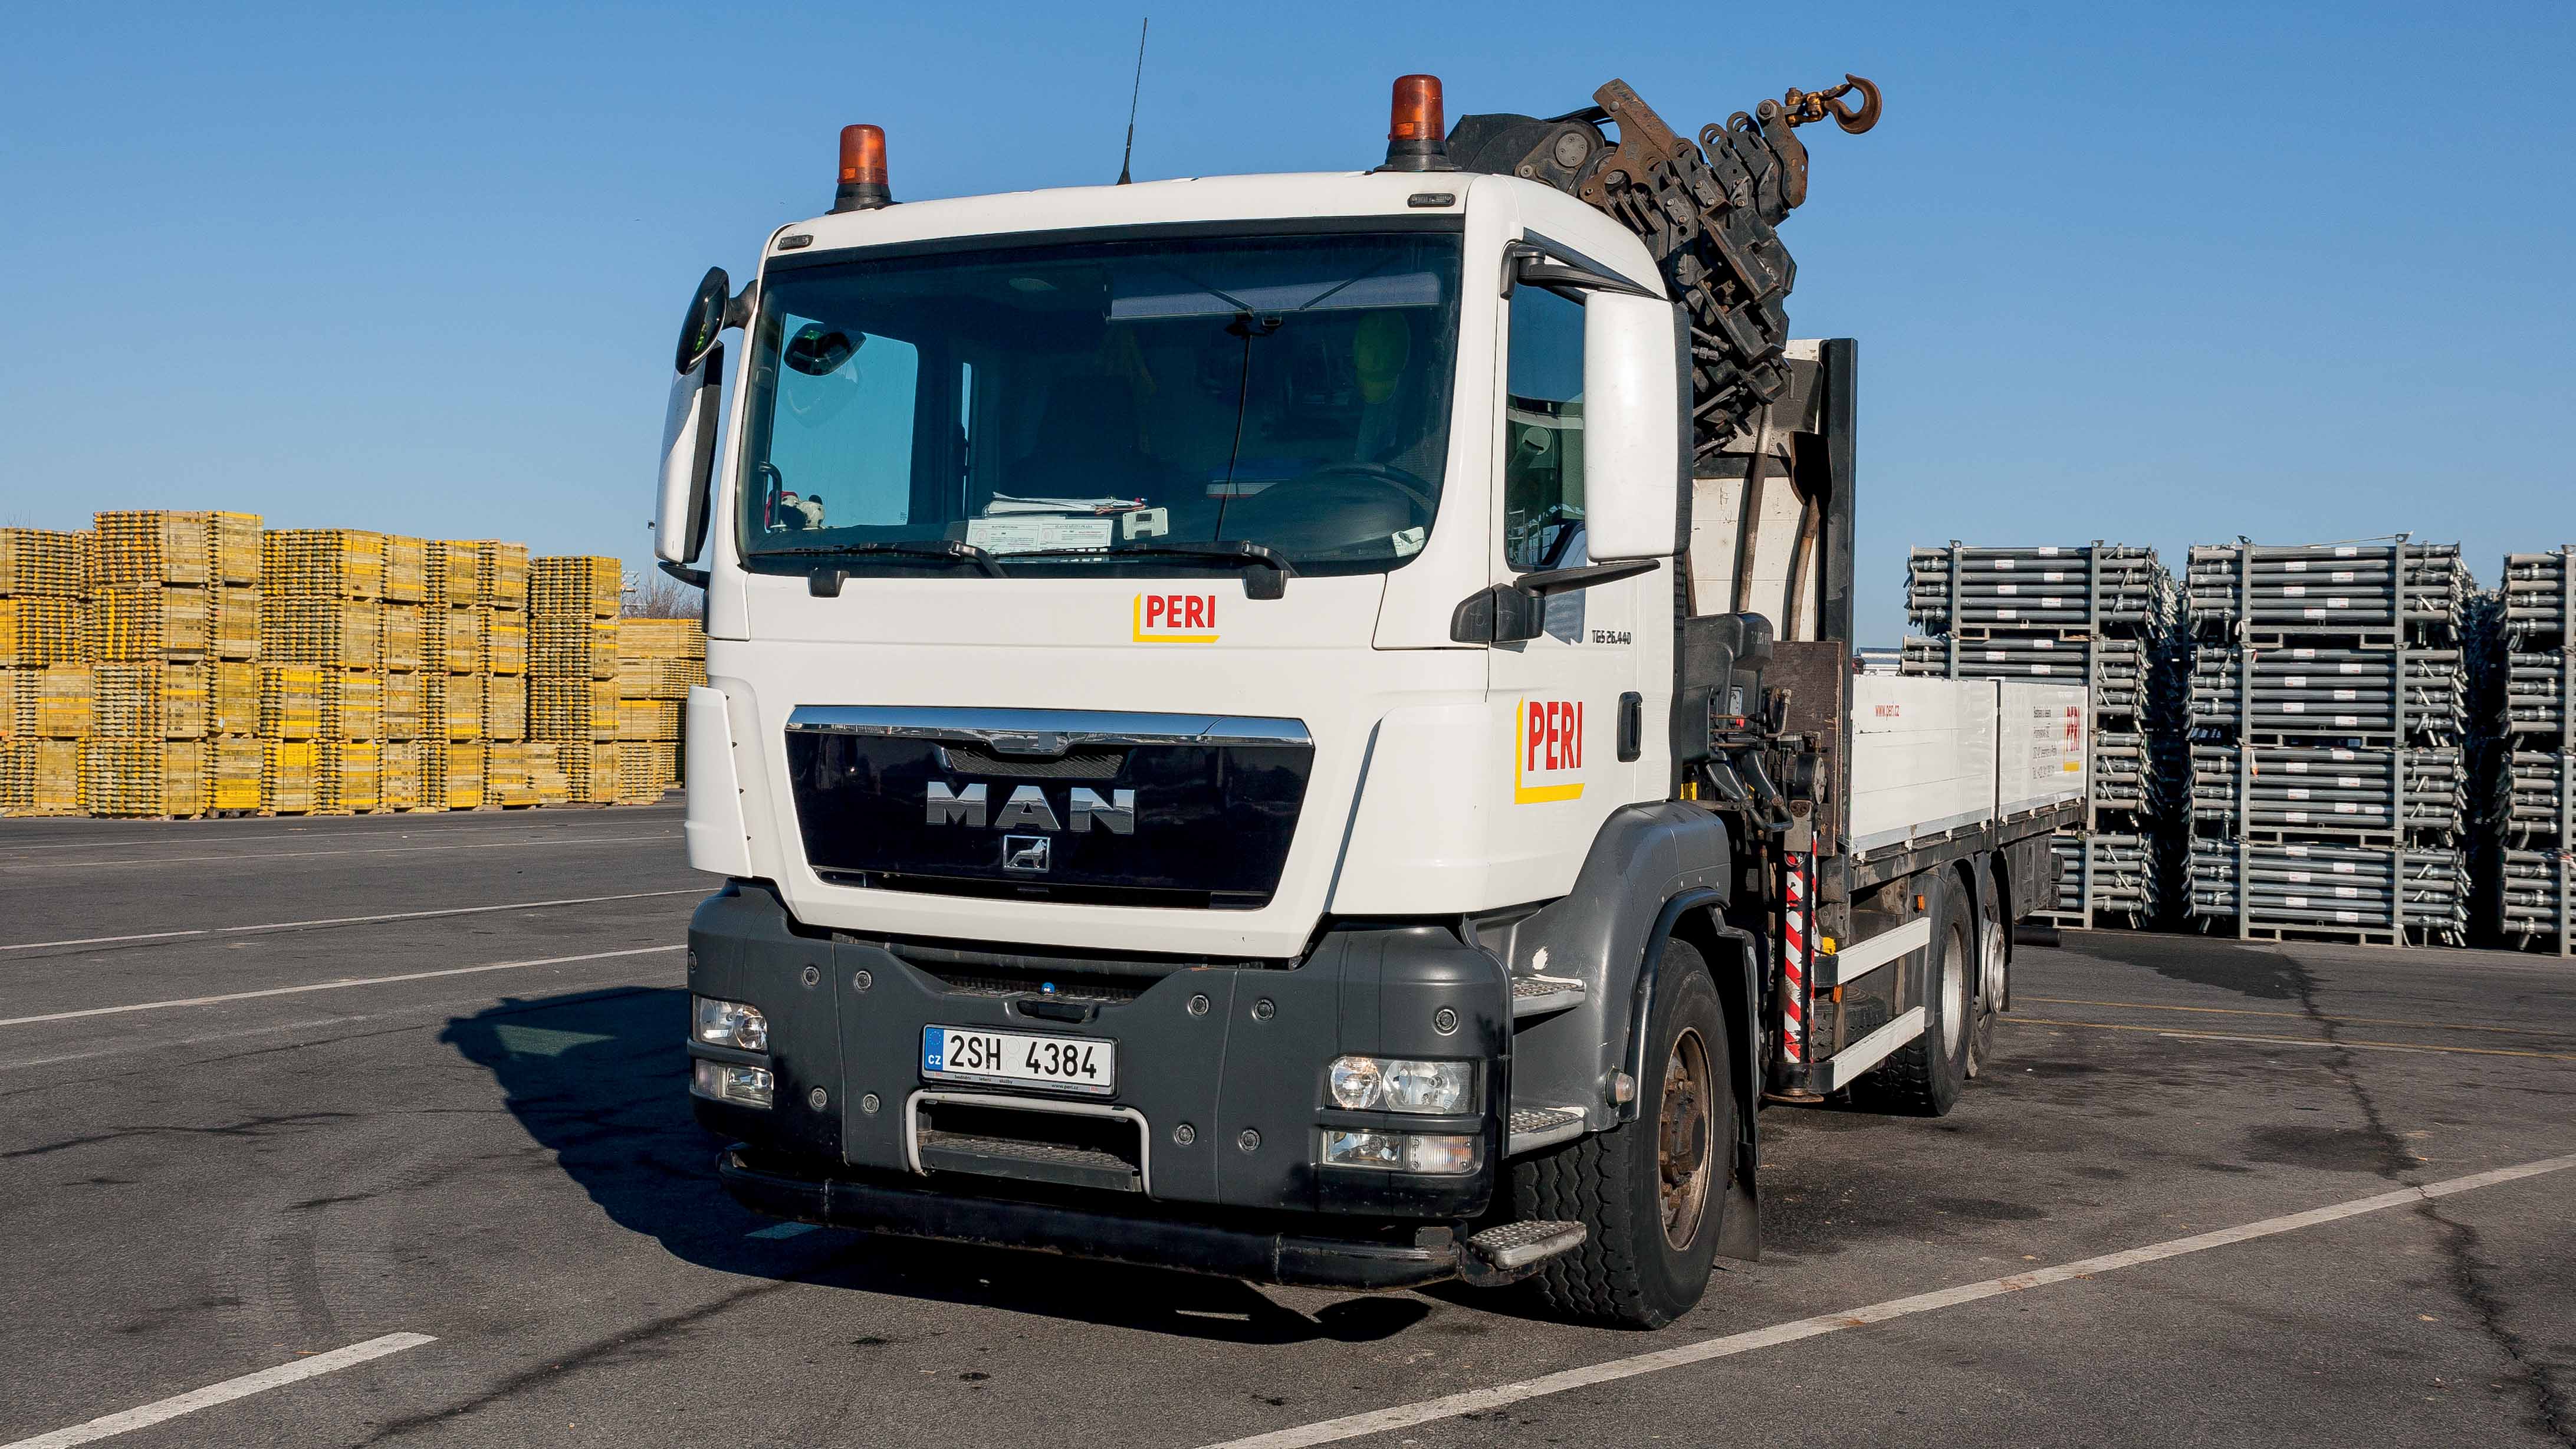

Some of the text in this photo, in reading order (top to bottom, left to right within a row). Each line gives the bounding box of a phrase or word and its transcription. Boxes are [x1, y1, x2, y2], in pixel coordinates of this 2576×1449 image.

[1146, 595, 1216, 628] PERI
[1592, 630, 1605, 643] TGS
[1528, 701, 1583, 771] PERI
[926, 781, 1135, 834] MAN
[928, 1054, 941, 1065] CZ
[949, 1034, 1097, 1079] 2SH 4384
